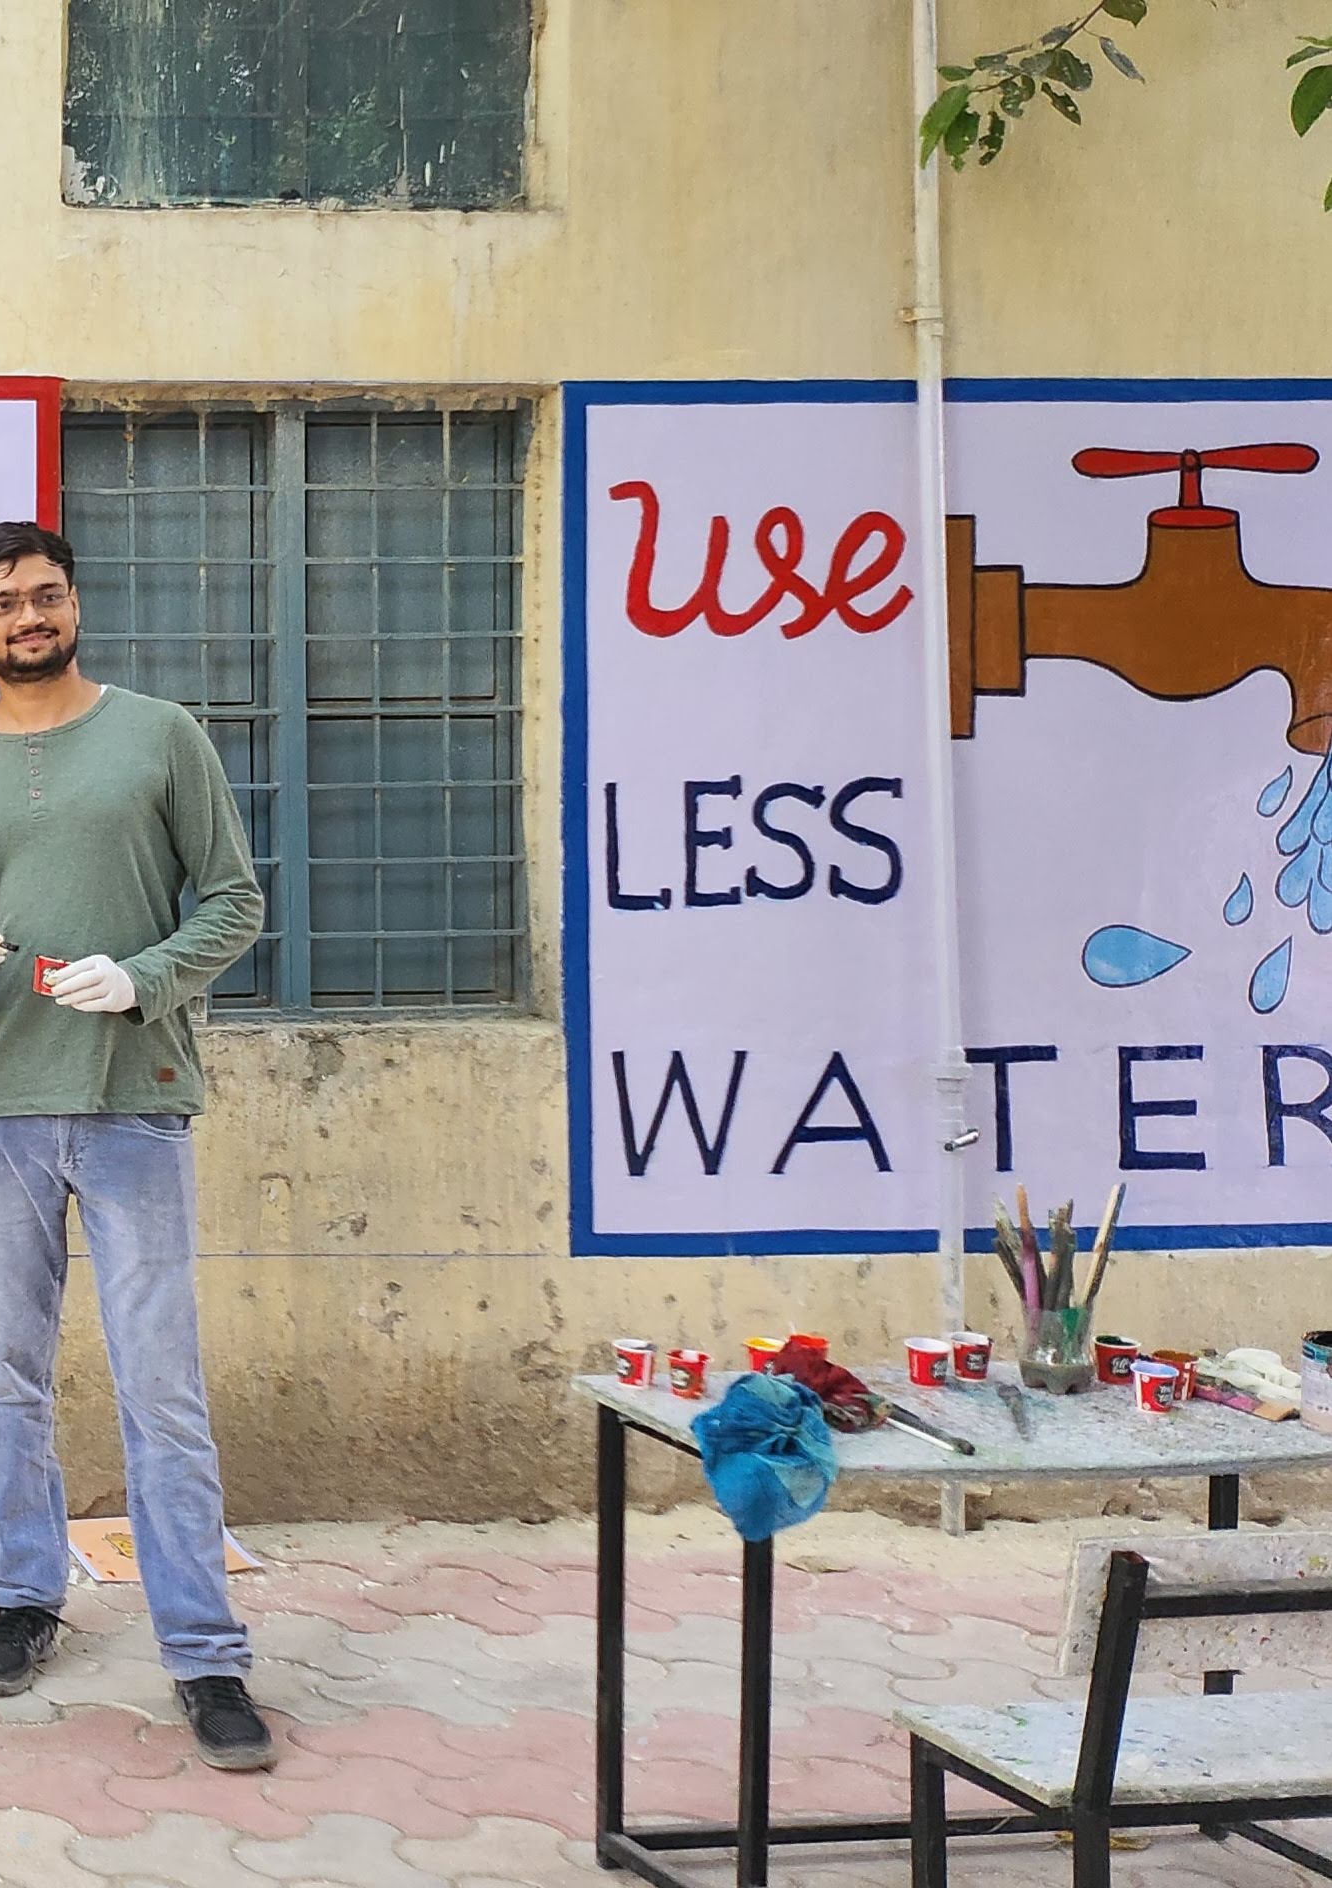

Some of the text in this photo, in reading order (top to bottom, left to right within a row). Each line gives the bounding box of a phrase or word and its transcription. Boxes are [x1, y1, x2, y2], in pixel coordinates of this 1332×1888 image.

[607, 479, 915, 640] Use
[604, 775, 903, 911] LESS
[611, 1043, 1332, 1177] WATER
